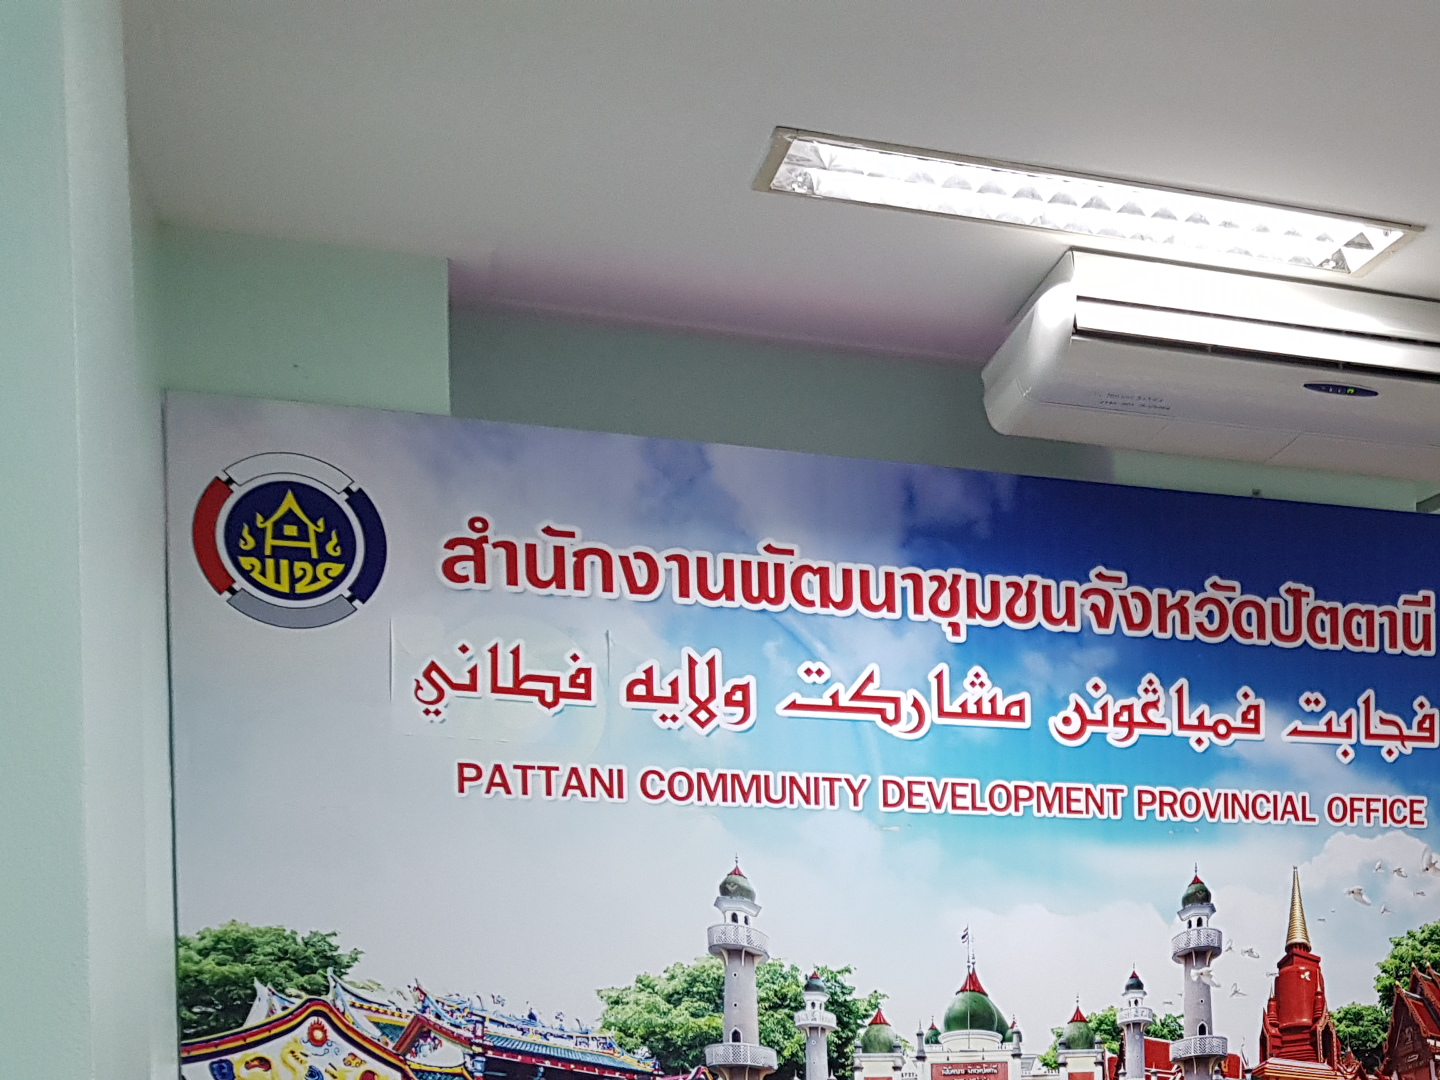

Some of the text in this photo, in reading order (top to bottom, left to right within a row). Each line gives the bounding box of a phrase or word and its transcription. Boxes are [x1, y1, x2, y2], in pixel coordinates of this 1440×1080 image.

[442, 517, 1433, 652] สำนักงานพัฒนาชุมชนจังหวัดปัตตานี
[458, 762, 1427, 826] PATTANI COMMUNITY DEVELOPMENT PROVINCIAL OFFICE
